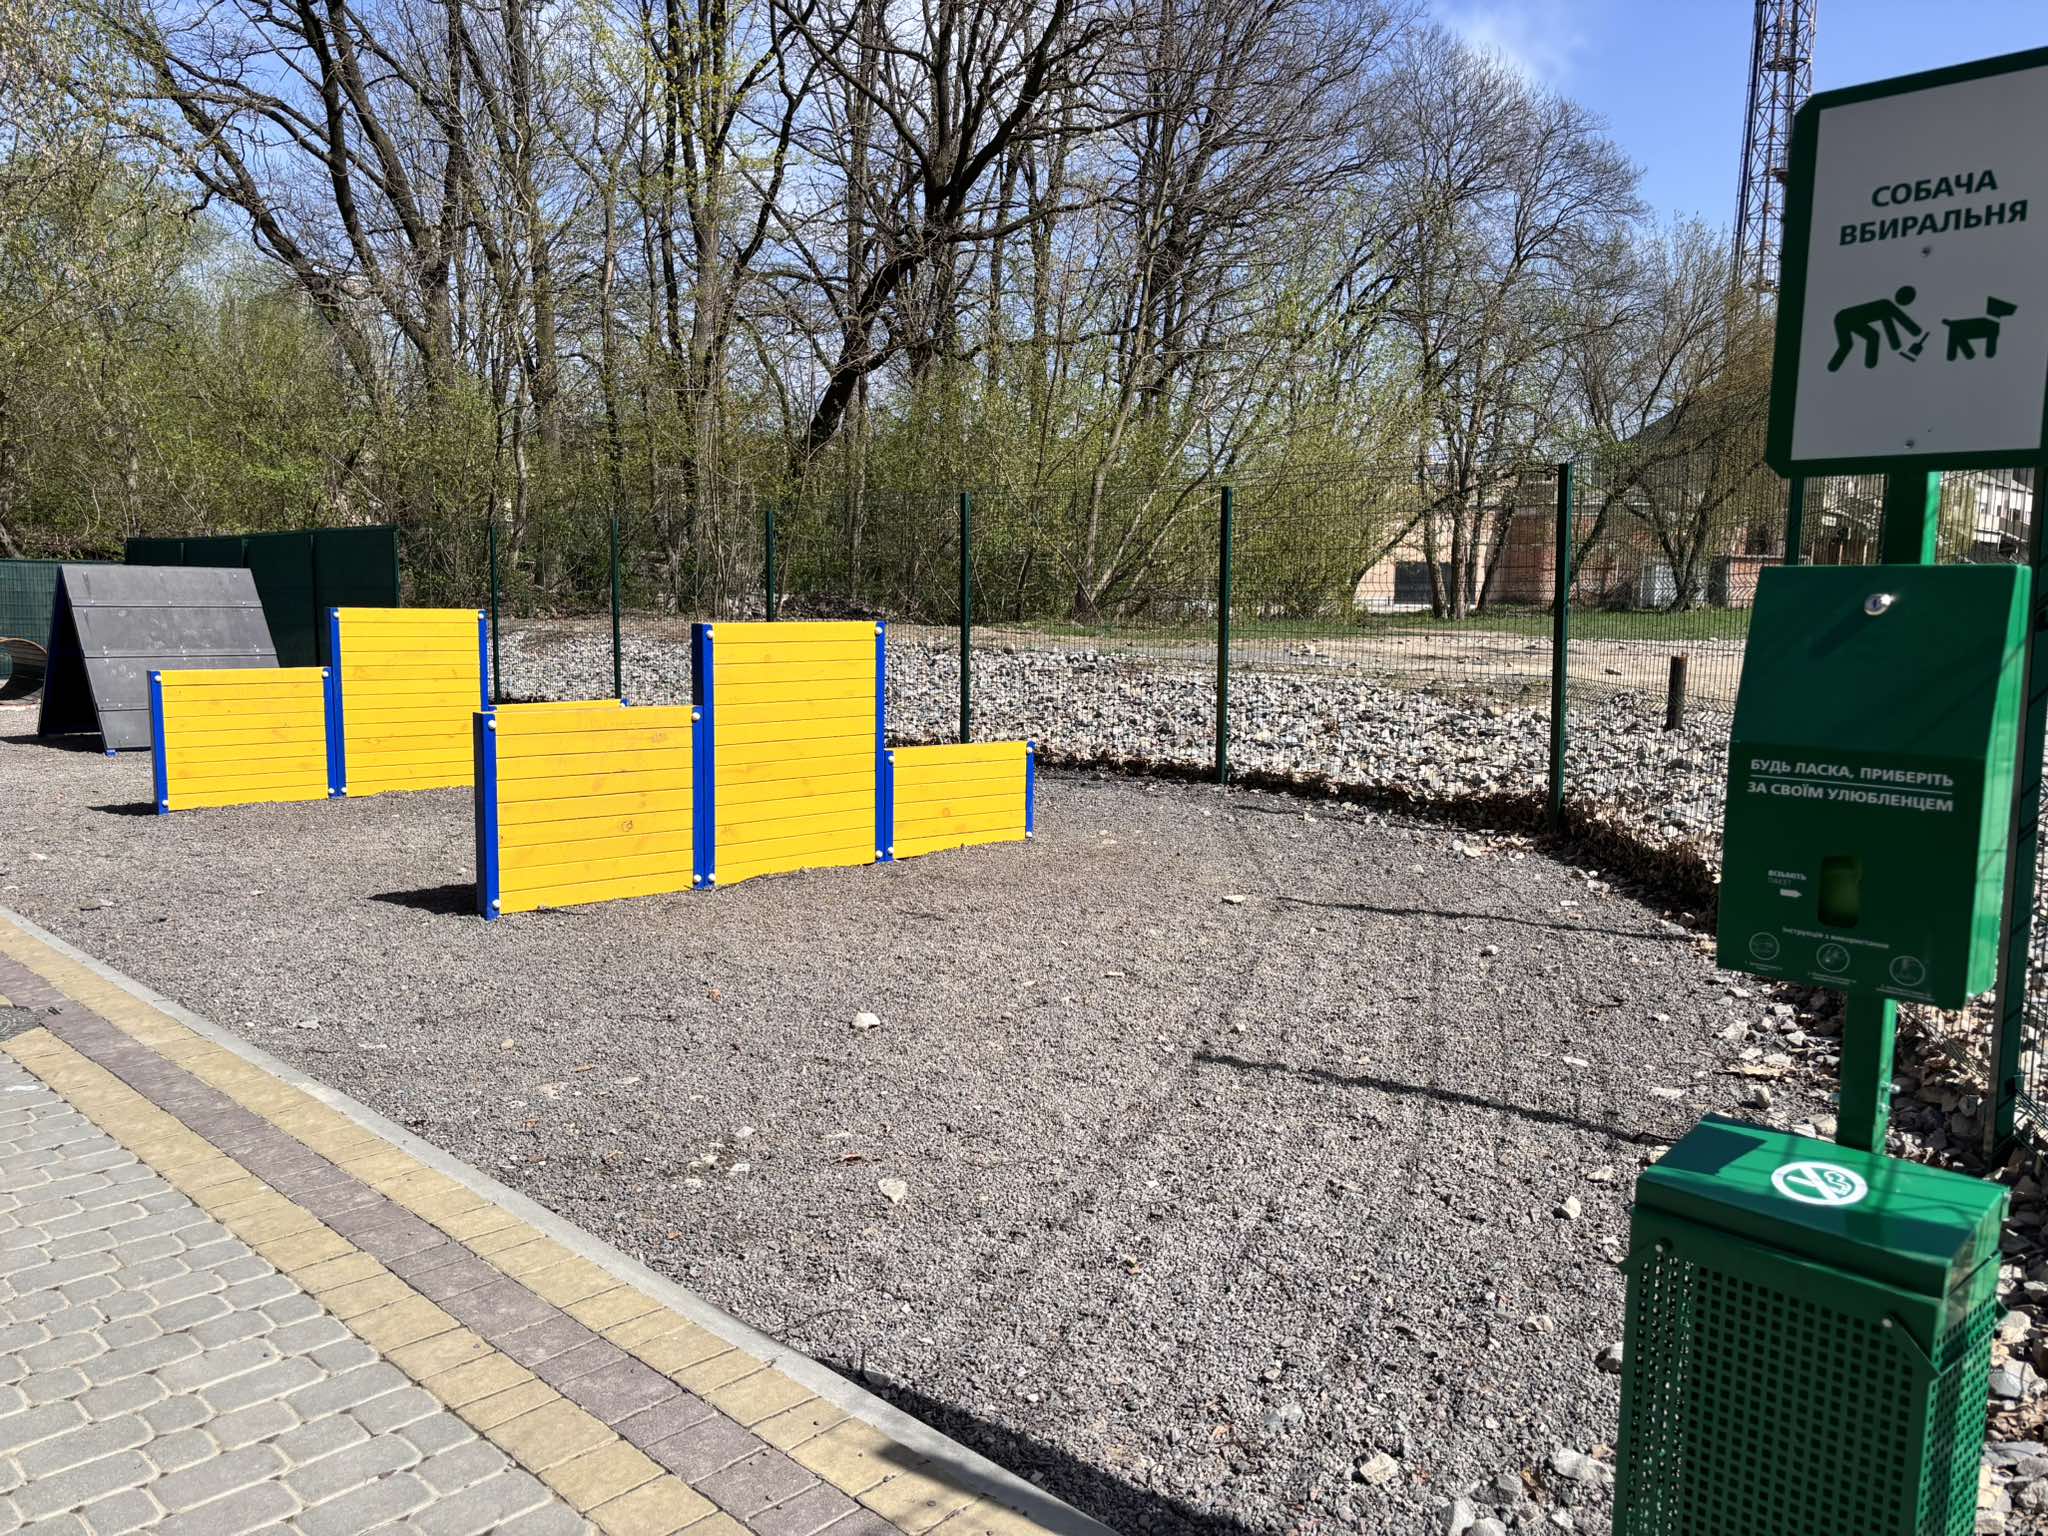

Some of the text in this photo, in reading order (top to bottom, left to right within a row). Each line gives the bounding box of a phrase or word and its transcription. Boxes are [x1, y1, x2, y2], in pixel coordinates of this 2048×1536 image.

[1871, 169, 1999, 208] СОБАЧА
[1839, 199, 2028, 246] ВБИРАЛЬНЯ
[1751, 759, 1954, 787] БУДЬ ЛАСКА, ПРИБЕРІТЬ
[1747, 781, 1953, 812] ЗА СВОЇМ УЛЮБЛЕНЦЕМ
